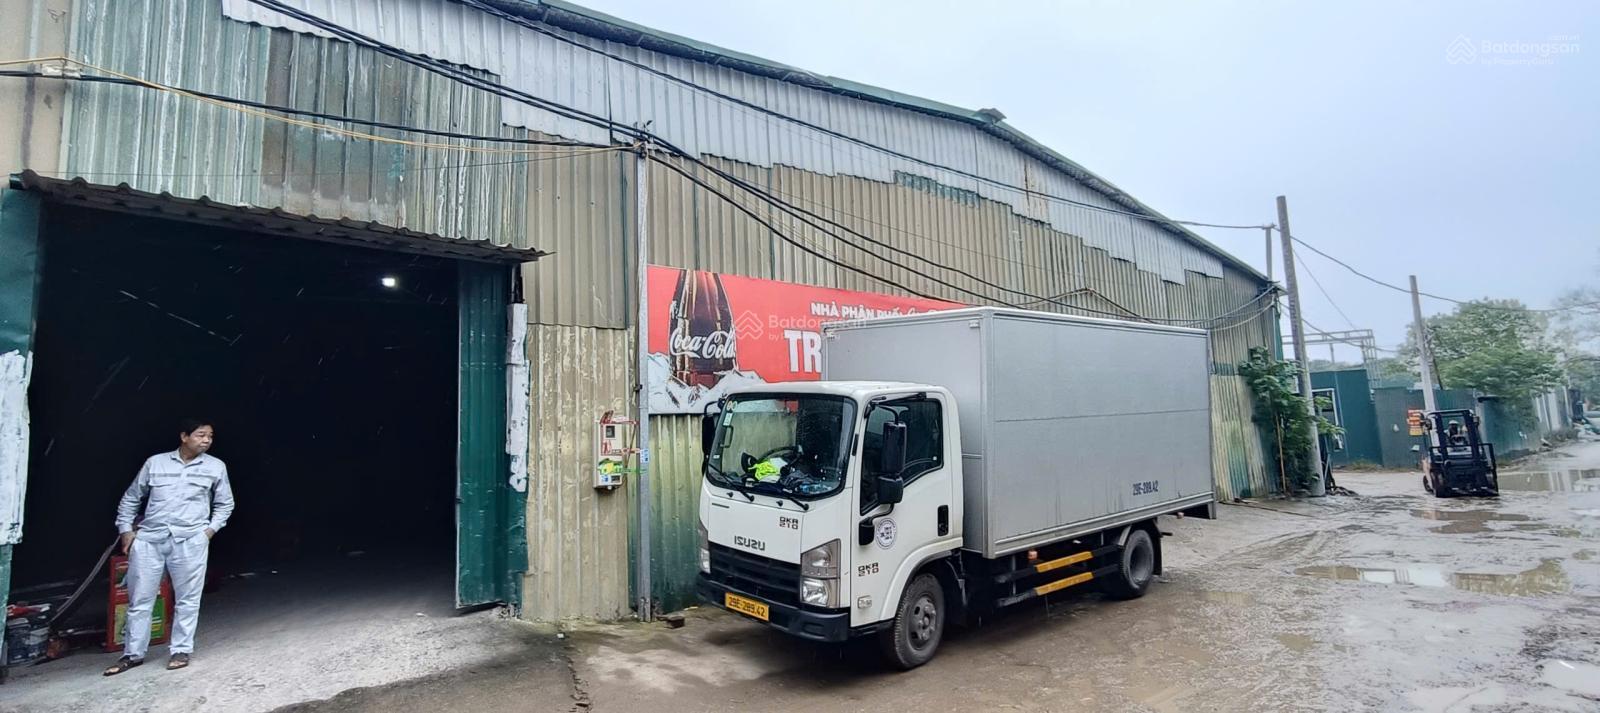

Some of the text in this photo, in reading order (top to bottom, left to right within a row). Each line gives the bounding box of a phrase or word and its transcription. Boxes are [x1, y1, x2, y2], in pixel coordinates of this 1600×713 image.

[811, 301, 840, 317] NHÀ
[841, 304, 875, 320] PHÂN
[734, 535, 765, 551] ISUZU
